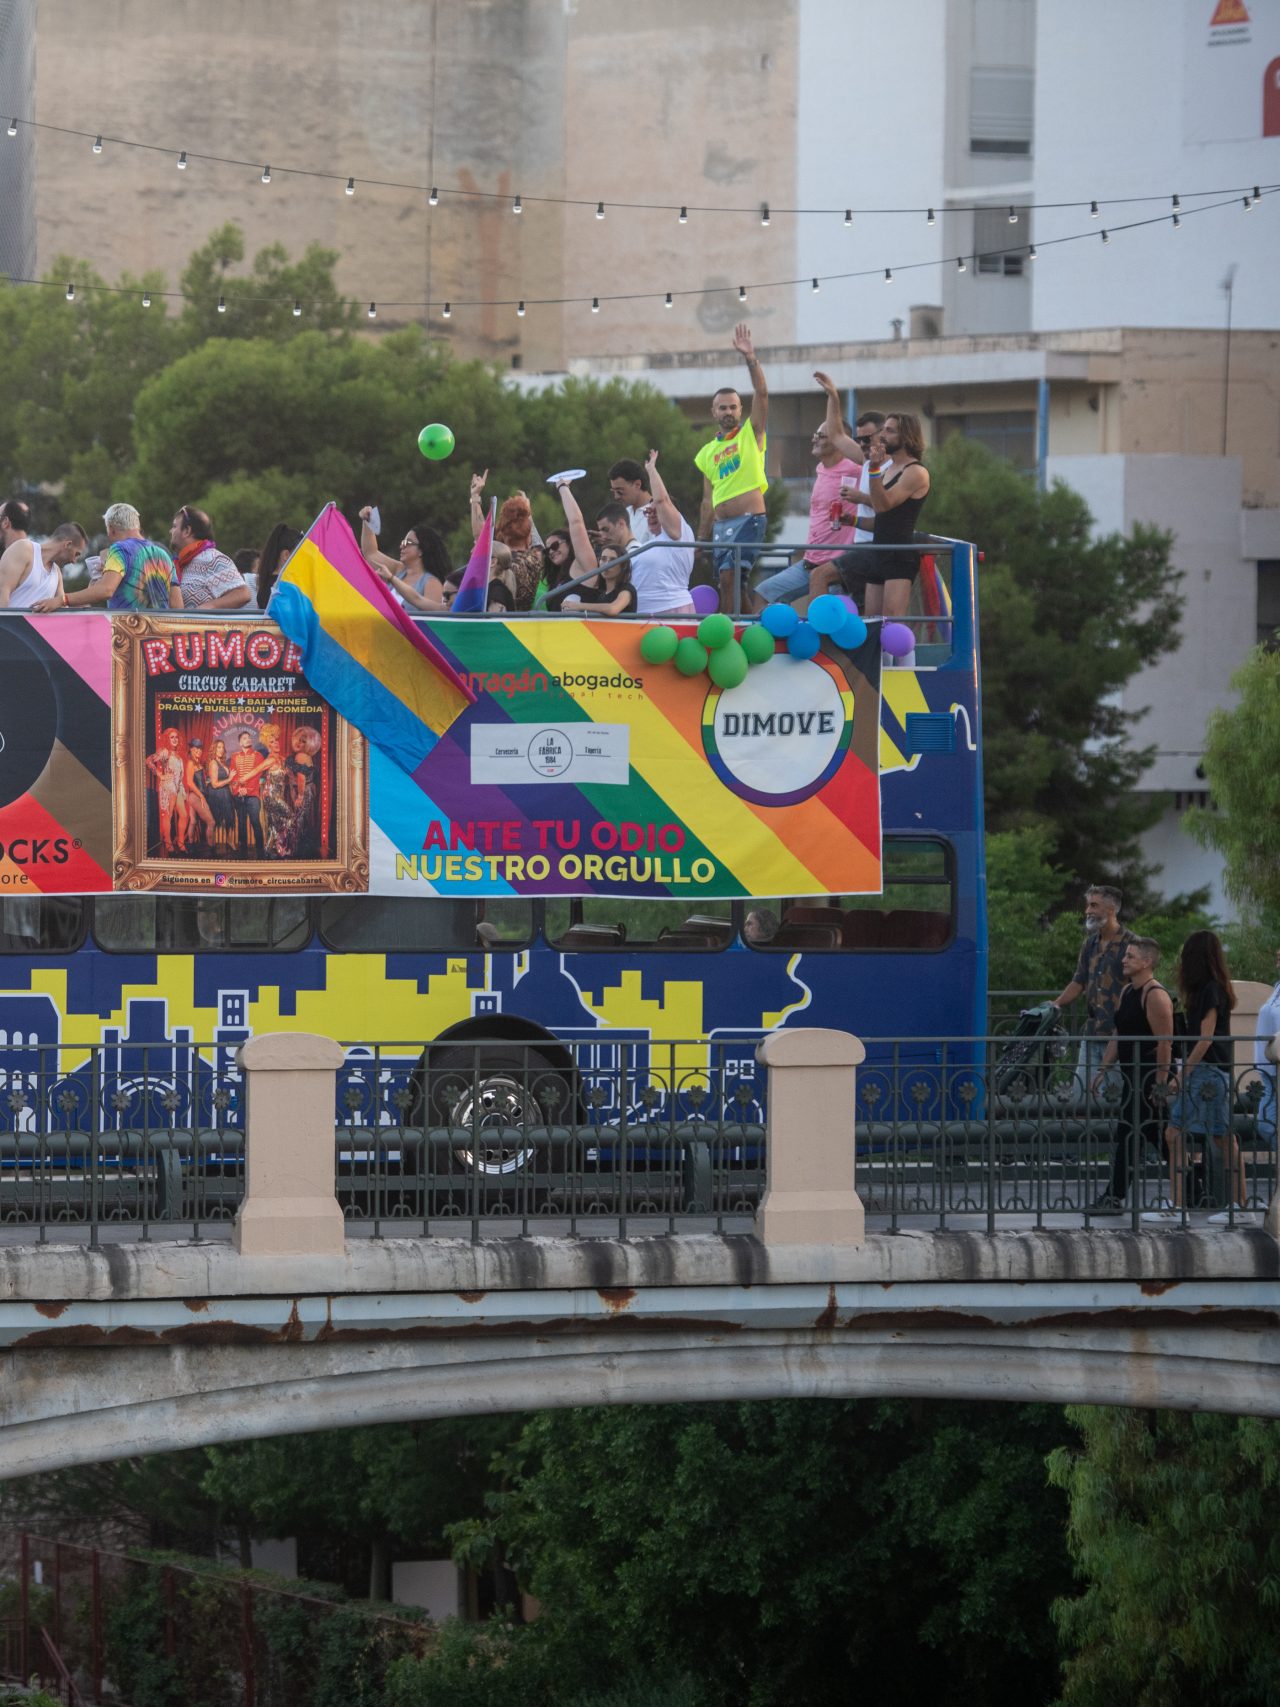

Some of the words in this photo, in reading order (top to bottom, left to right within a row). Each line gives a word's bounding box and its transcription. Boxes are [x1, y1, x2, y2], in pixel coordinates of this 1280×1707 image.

[143, 631, 304, 677] RUMOR
[179, 675, 228, 692] CIRCUS
[232, 676, 296, 693] CABARET
[460, 667, 548, 698] rragán
[552, 672, 644, 690] abogados
[174, 696, 237, 705] CANTANTES
[204, 705, 266, 713] BURLESQUE
[608, 693, 644, 701] tech
[212, 712, 265, 737] RUMOR
[723, 710, 835, 737] DIMOVE
[546, 737, 554, 746] LA
[422, 820, 522, 850] ANTE
[532, 820, 580, 849] TU
[591, 822, 685, 853] ODIO
[395, 853, 550, 881] NUESTRO
[558, 854, 716, 884] ORGULLO
